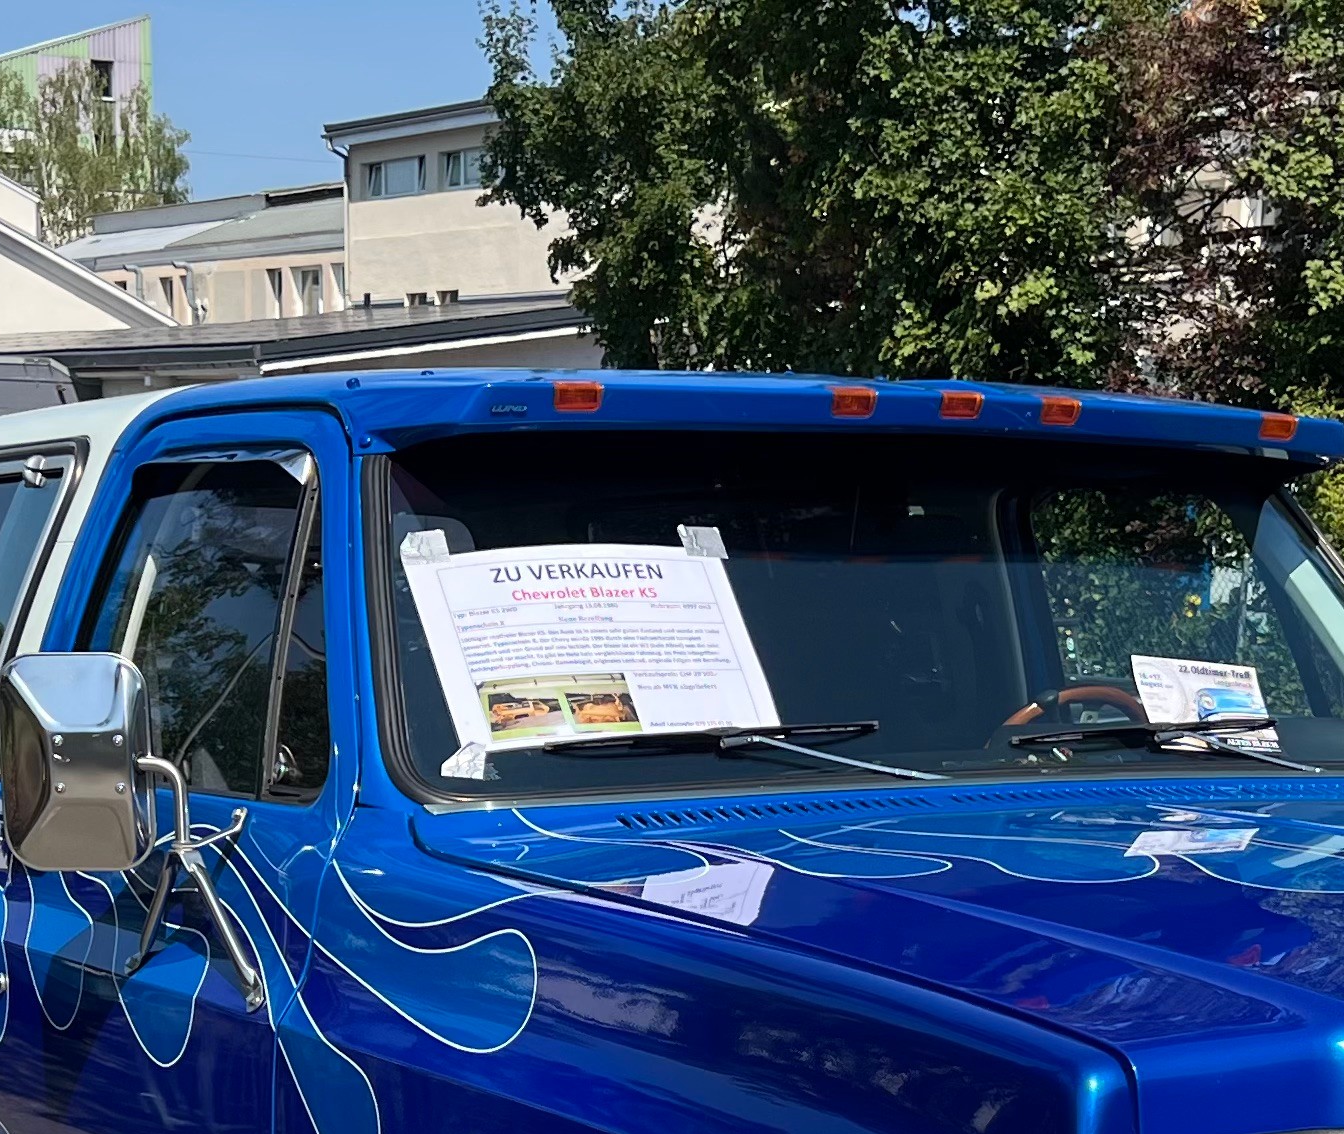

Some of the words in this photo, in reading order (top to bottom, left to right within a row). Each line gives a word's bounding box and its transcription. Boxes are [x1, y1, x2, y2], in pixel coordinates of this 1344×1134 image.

[489, 566, 522, 584] ZU
[526, 562, 664, 581] VERKAUFEN
[511, 585, 586, 602] Chevrolet
[590, 585, 635, 600] Blazer
[639, 586, 658, 600] K5
